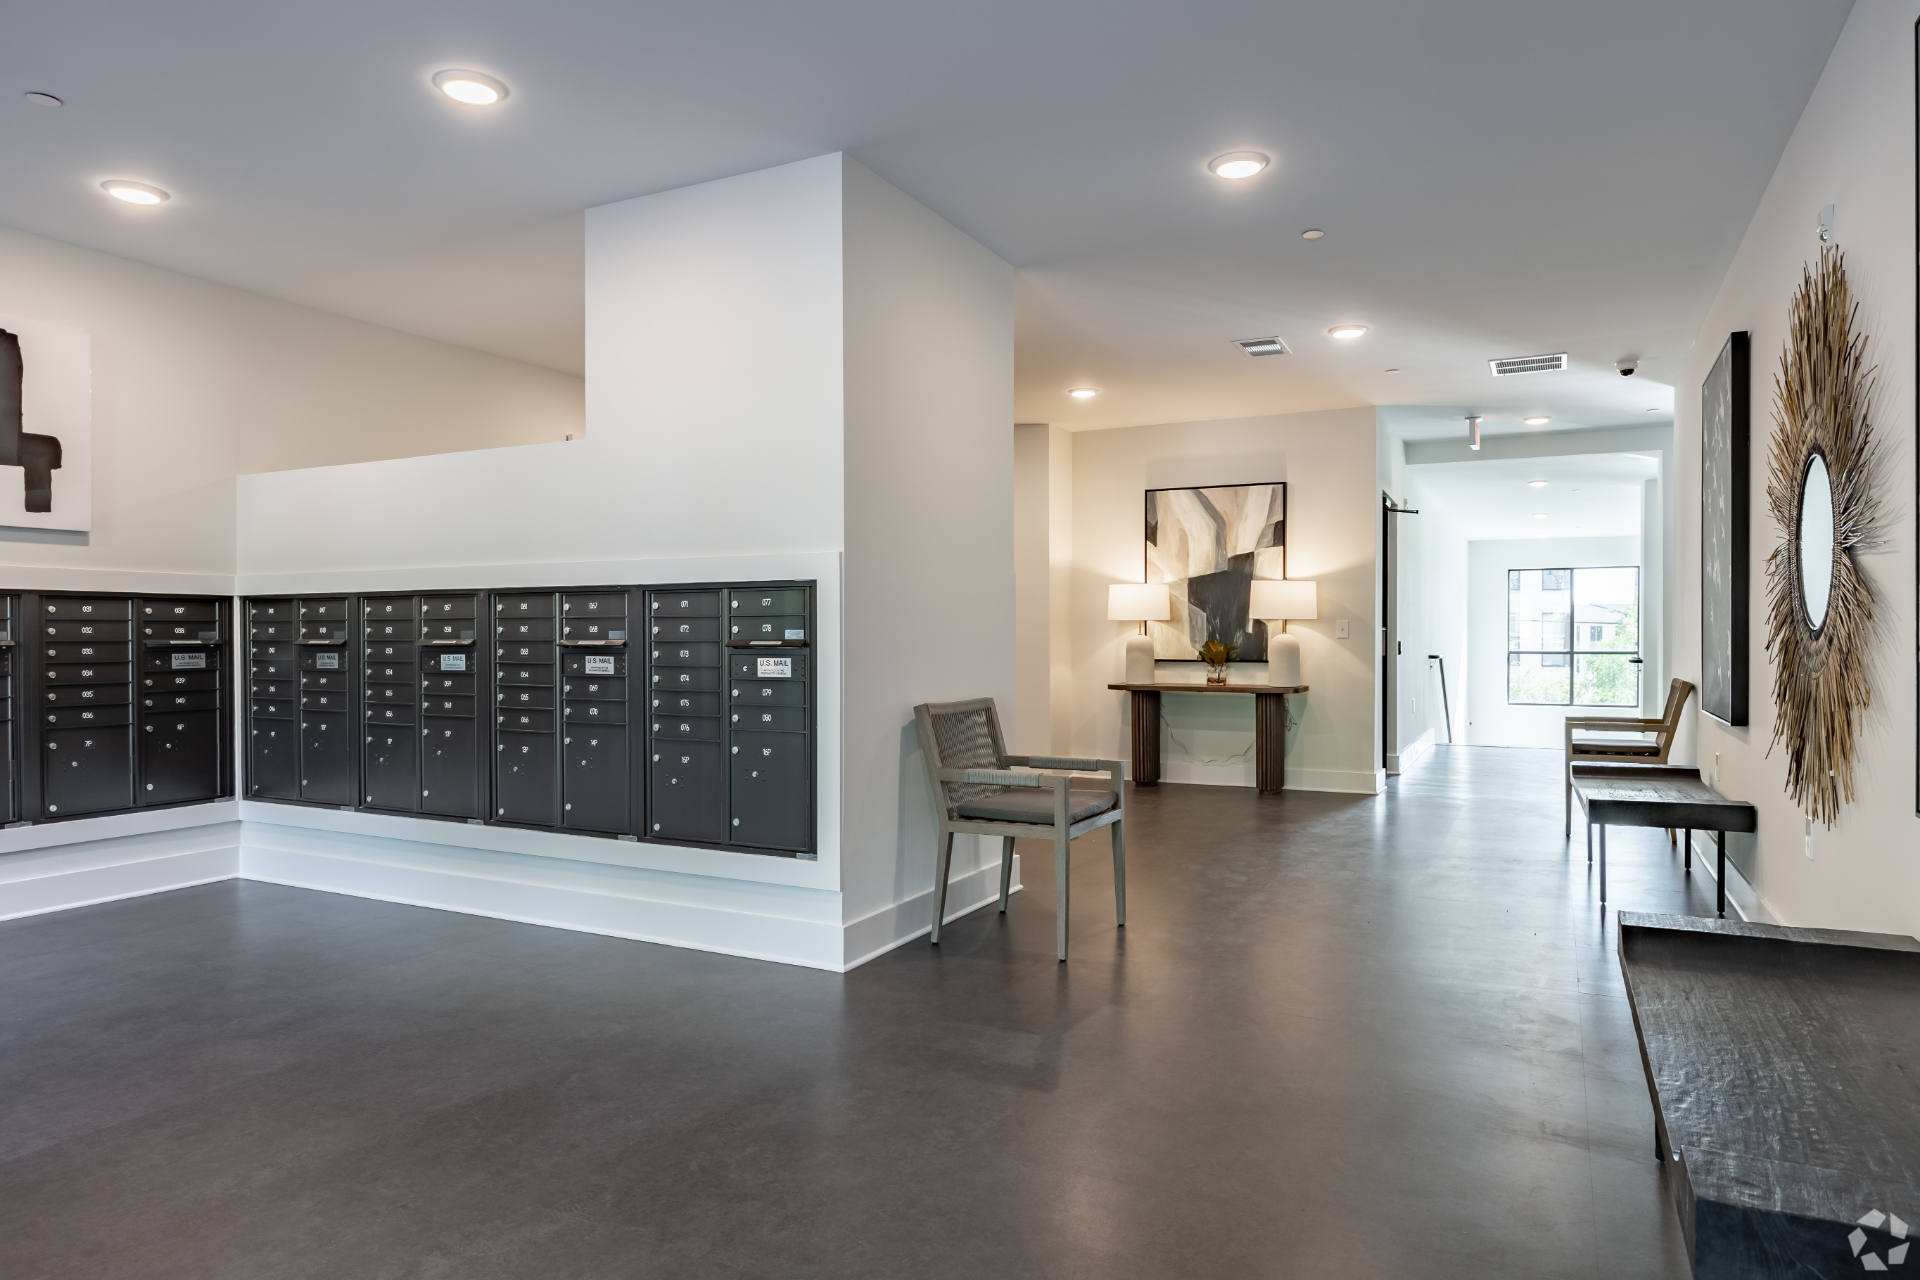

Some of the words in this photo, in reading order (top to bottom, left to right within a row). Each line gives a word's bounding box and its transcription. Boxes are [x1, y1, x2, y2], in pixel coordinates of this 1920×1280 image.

[761, 597, 772, 607] 077
[174, 606, 185, 615] 037
[81, 626, 93, 634] 032
[679, 624, 690, 633] 072
[761, 623, 772, 633] 078
[81, 647, 94, 655] 033
[679, 649, 690, 658] 073
[598, 657, 612, 665] MAIL
[759, 659, 773, 667] U.S.
[773, 659, 789, 667] MAIL
[81, 669, 94, 677] 034
[679, 674, 690, 683] 074
[81, 690, 94, 698] 035
[761, 688, 773, 697] 079
[679, 698, 690, 707] 075
[81, 711, 94, 719] 036
[761, 713, 772, 722] 080
[680, 723, 691, 732] 076
[762, 747, 772, 757] 16P
